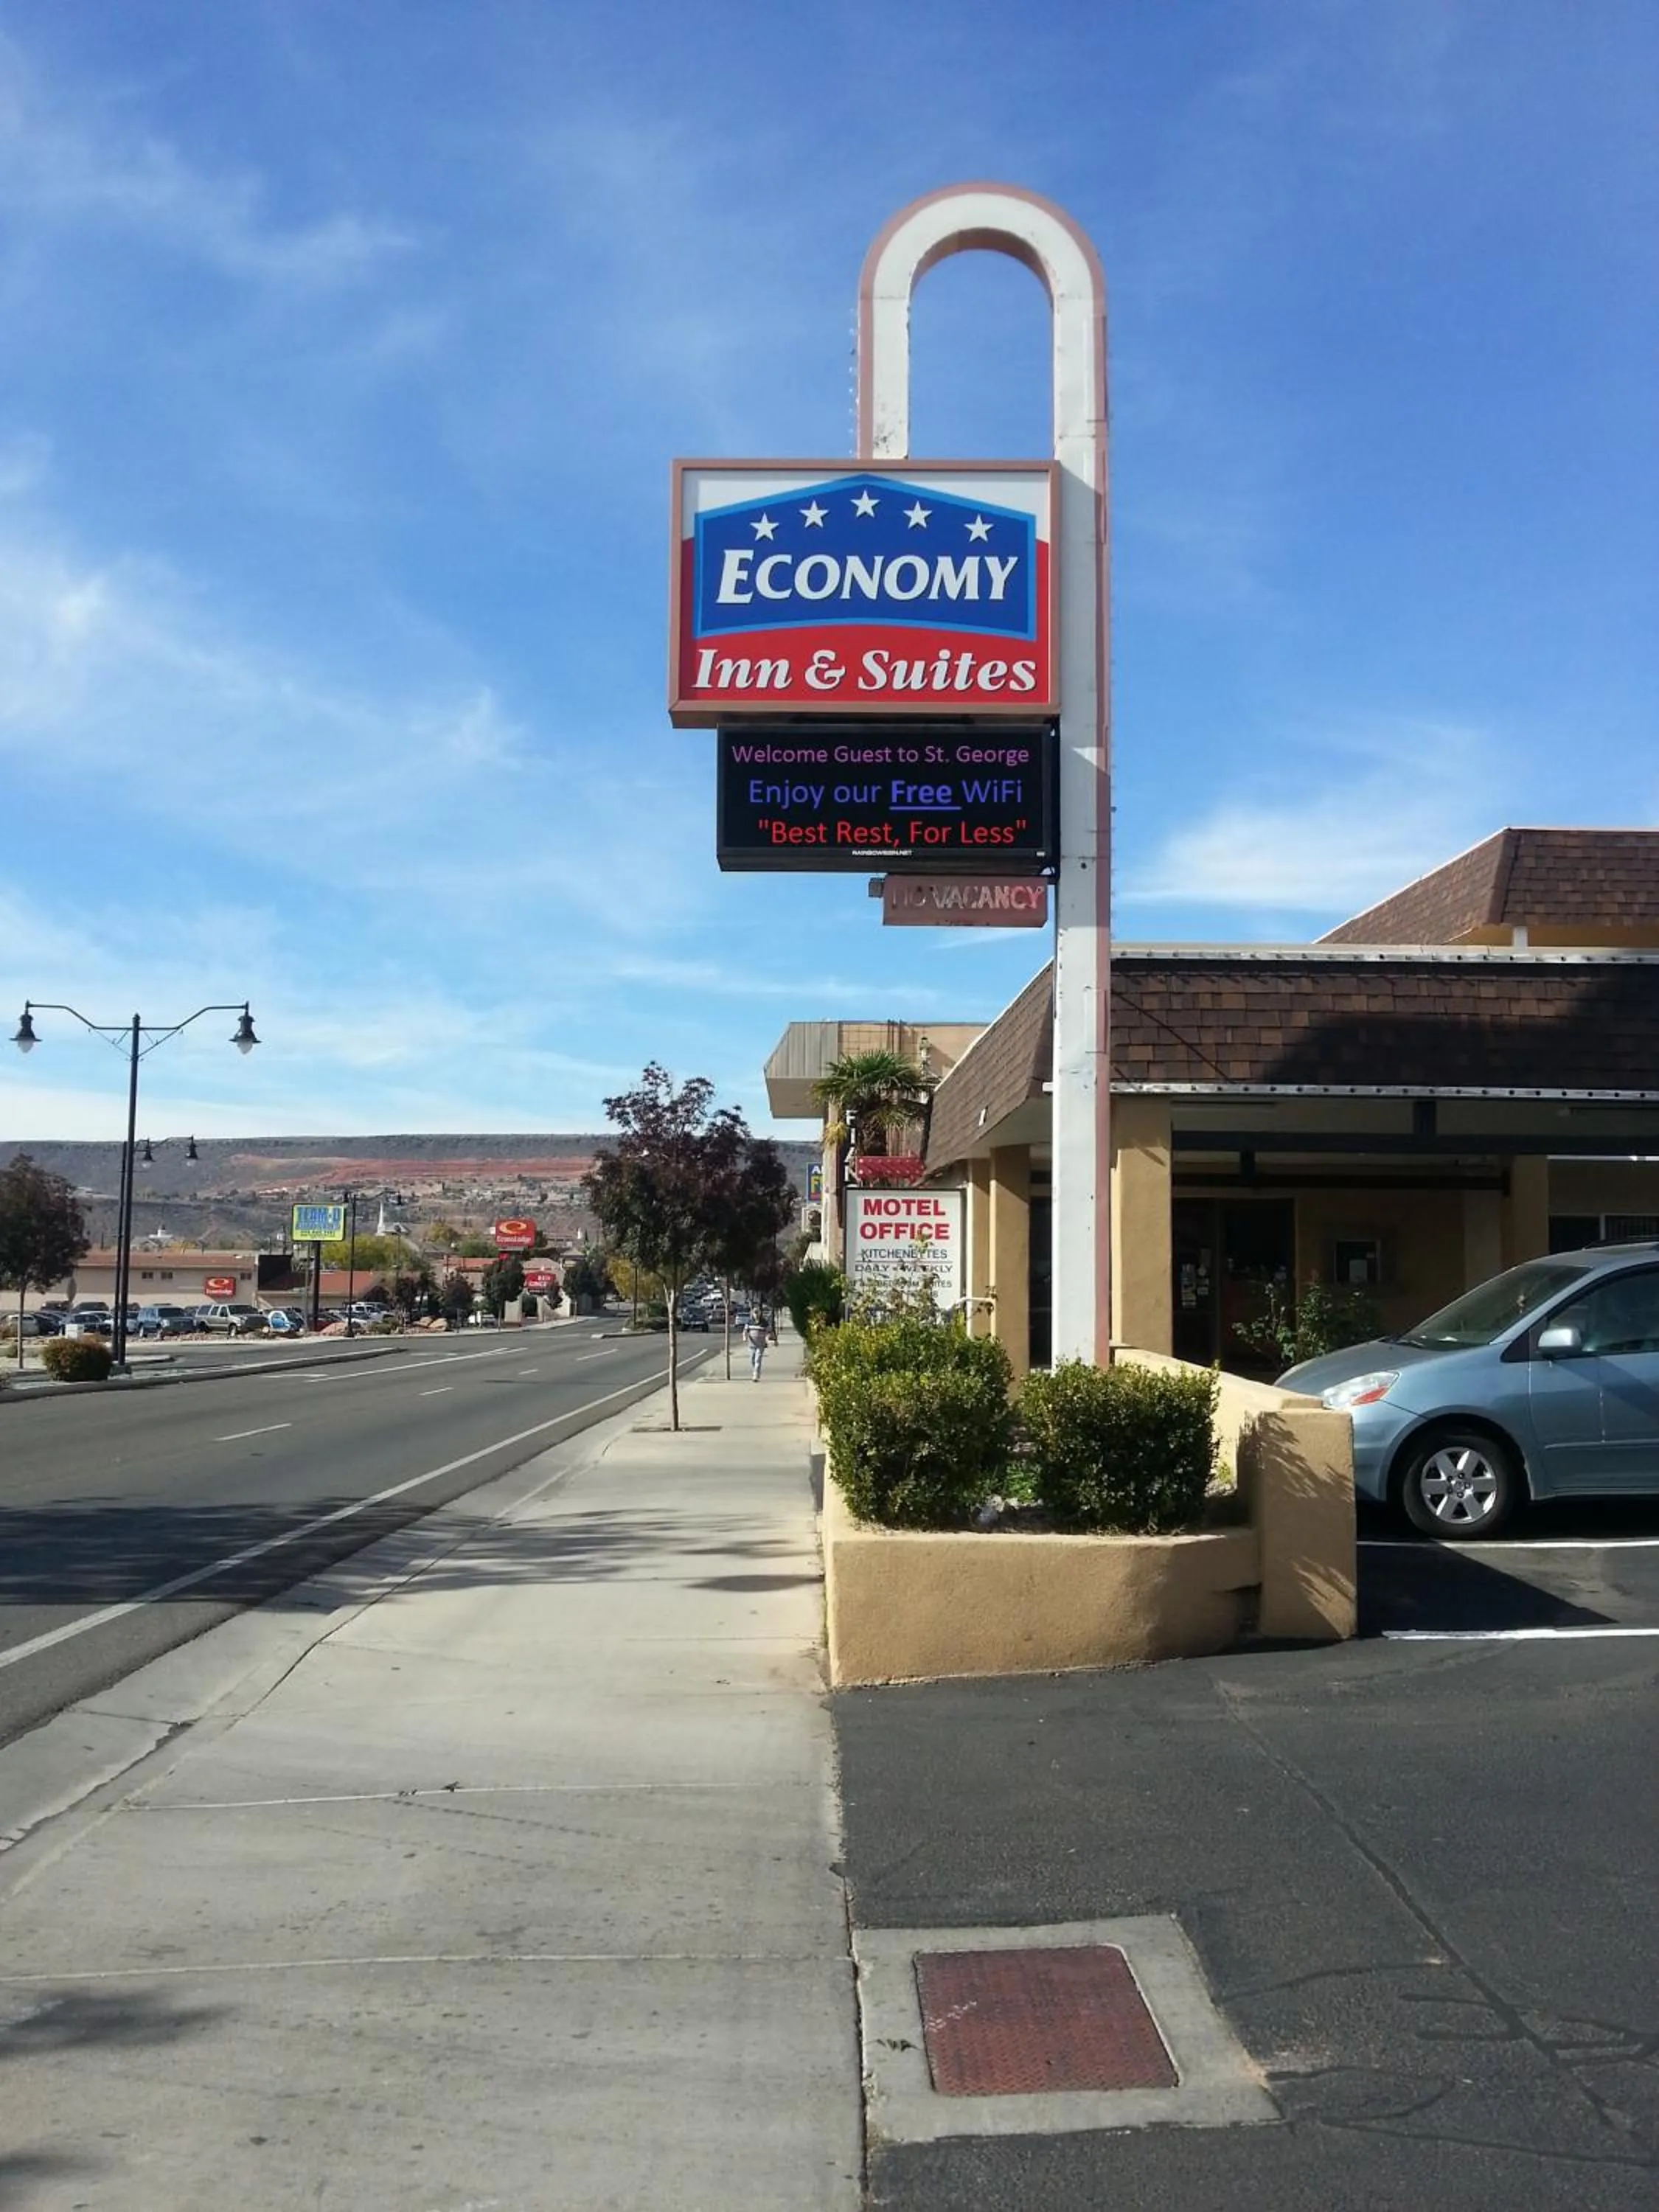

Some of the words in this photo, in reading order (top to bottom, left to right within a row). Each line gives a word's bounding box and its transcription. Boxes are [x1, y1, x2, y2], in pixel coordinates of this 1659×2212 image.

[716, 549, 1019, 604] ECONOMY
[692, 649, 792, 689] Inn
[804, 649, 846, 690] &
[858, 649, 1037, 691] Suites
[731, 745, 828, 763] Welcome
[834, 745, 891, 763] Guest
[898, 748, 919, 763] to
[924, 745, 950, 763] St.
[956, 745, 1030, 766] George
[749, 779, 825, 810] Enjoy
[834, 785, 881, 804] our
[890, 779, 953, 804] Free
[961, 779, 1023, 804] WiFi
[758, 819, 827, 844] "Best
[837, 821, 900, 847] Rest,
[910, 821, 953, 844] For
[961, 819, 1027, 844] Less"
[930, 886, 1045, 909] VACANCY
[863, 1198, 946, 1217] MOTEL
[859, 1222, 950, 1240] OFFICE
